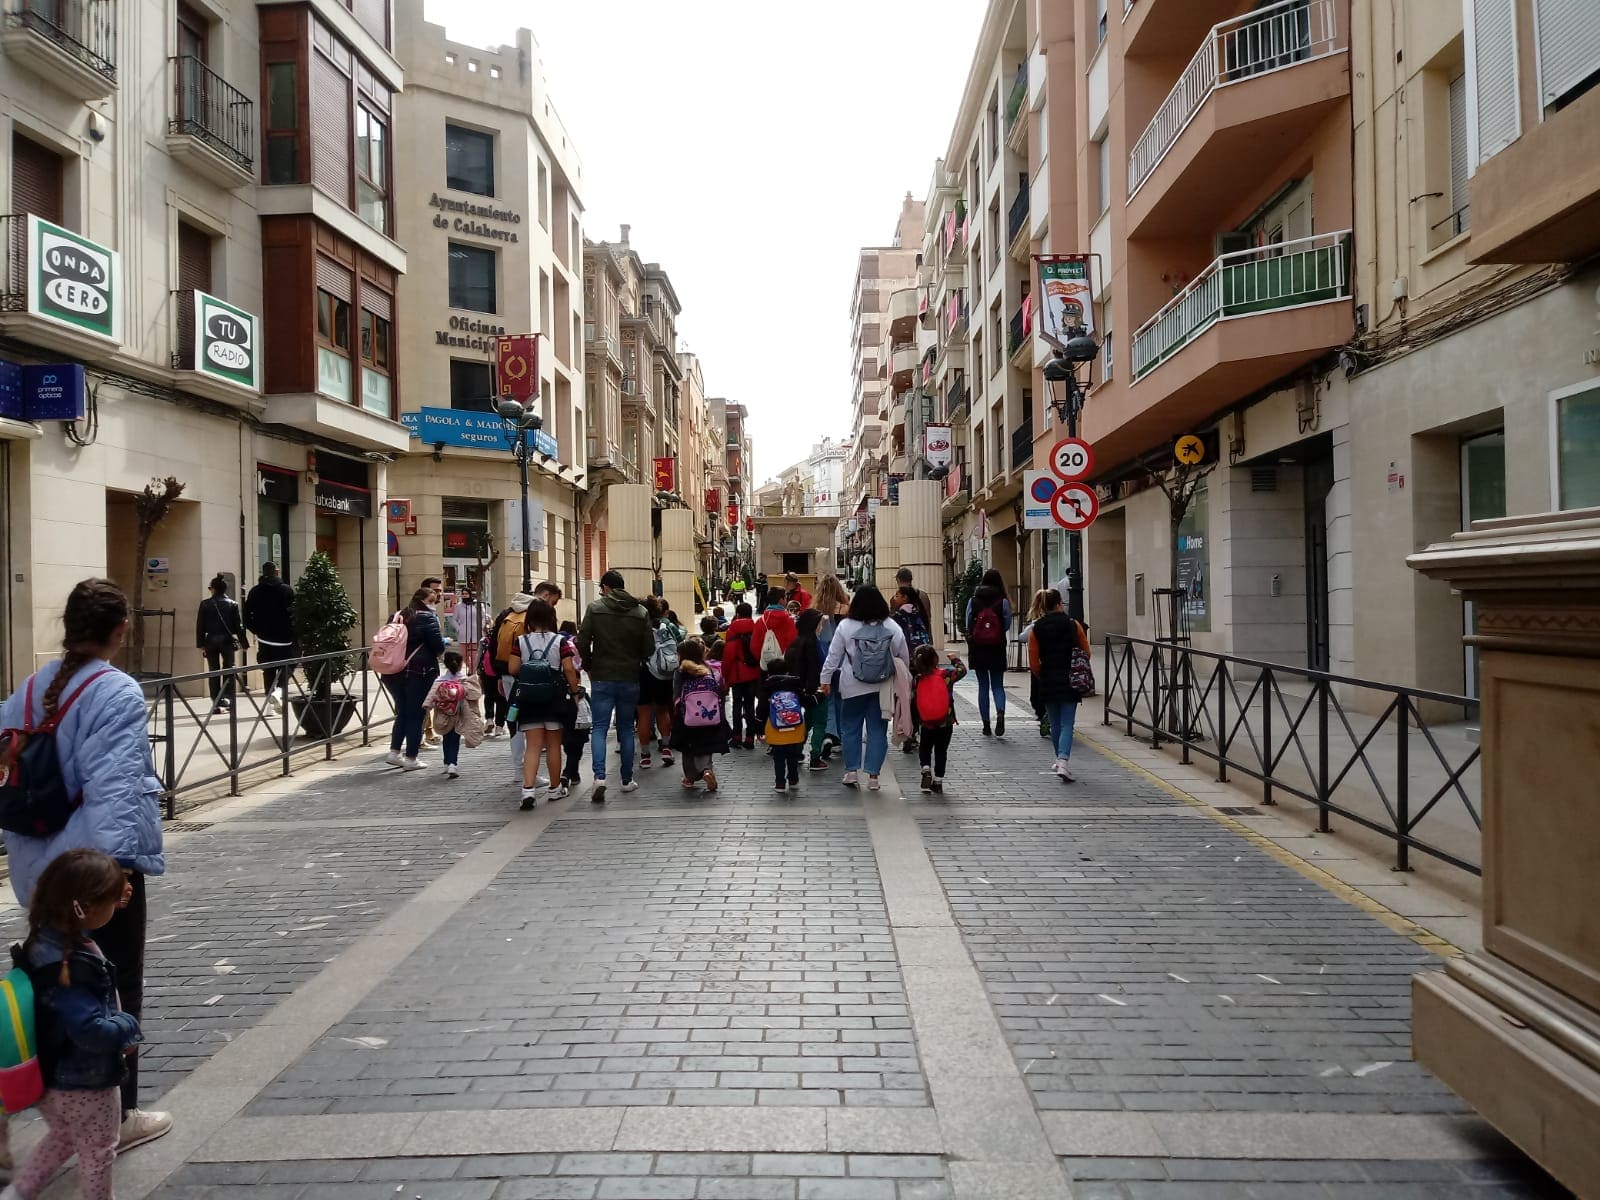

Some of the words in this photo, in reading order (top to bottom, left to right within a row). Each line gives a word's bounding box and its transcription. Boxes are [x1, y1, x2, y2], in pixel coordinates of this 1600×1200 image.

[429, 192, 521, 224] Ayuntamiento
[432, 213, 449, 230] de
[453, 217, 519, 243] Calahorra
[51, 250, 101, 281] ONDA
[54, 282, 100, 310] CERO
[218, 320, 236, 340] TU
[449, 315, 505, 335] Oficinas
[435, 330, 496, 354] Municipa
[213, 344, 245, 366] RADIO
[425, 415, 461, 426] PAGOLA
[465, 418, 473, 427] &
[460, 432, 498, 443] seguros
[1060, 452, 1084, 468] 20
